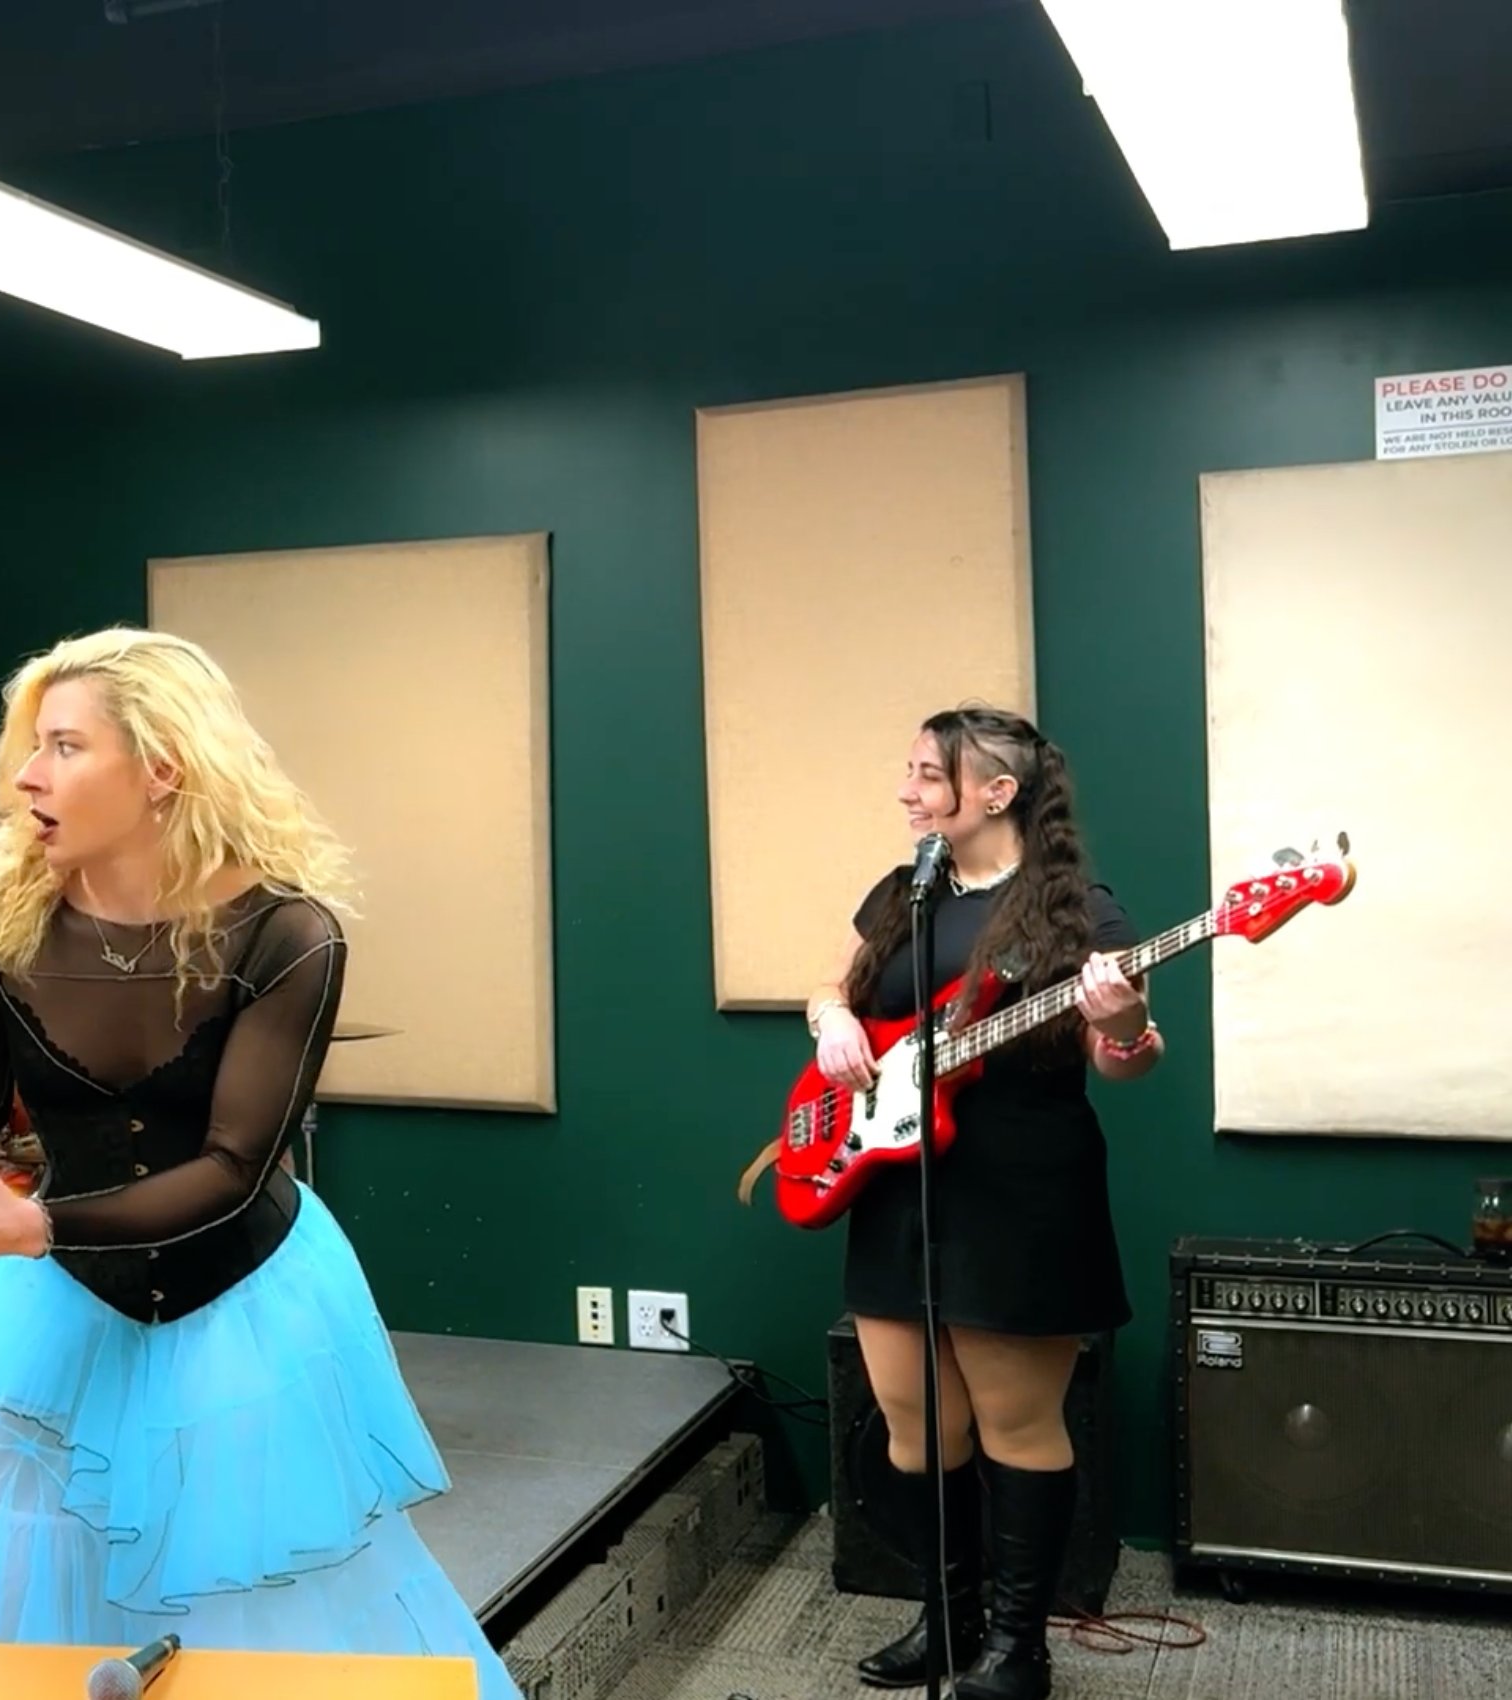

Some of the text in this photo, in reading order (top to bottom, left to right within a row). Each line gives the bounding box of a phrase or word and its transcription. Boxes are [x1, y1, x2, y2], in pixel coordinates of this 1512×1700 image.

[1382, 372, 1507, 398] PLEASE DO
[1386, 397, 1433, 412] LEAVE
[1437, 395, 1469, 407] ANY
[1420, 413, 1436, 424] IN
[1441, 409, 1474, 421] THIS
[1384, 435, 1401, 445] WE
[1404, 432, 1426, 442] ARE
[1429, 431, 1453, 441] NOT
[1456, 428, 1486, 439] HELD
[1384, 445, 1405, 454] FOR
[1409, 444, 1431, 453] ANY
[1434, 439, 1478, 450] STOLEN
[1481, 437, 1497, 447] OR
[1197, 1354, 1242, 1368] Roland
